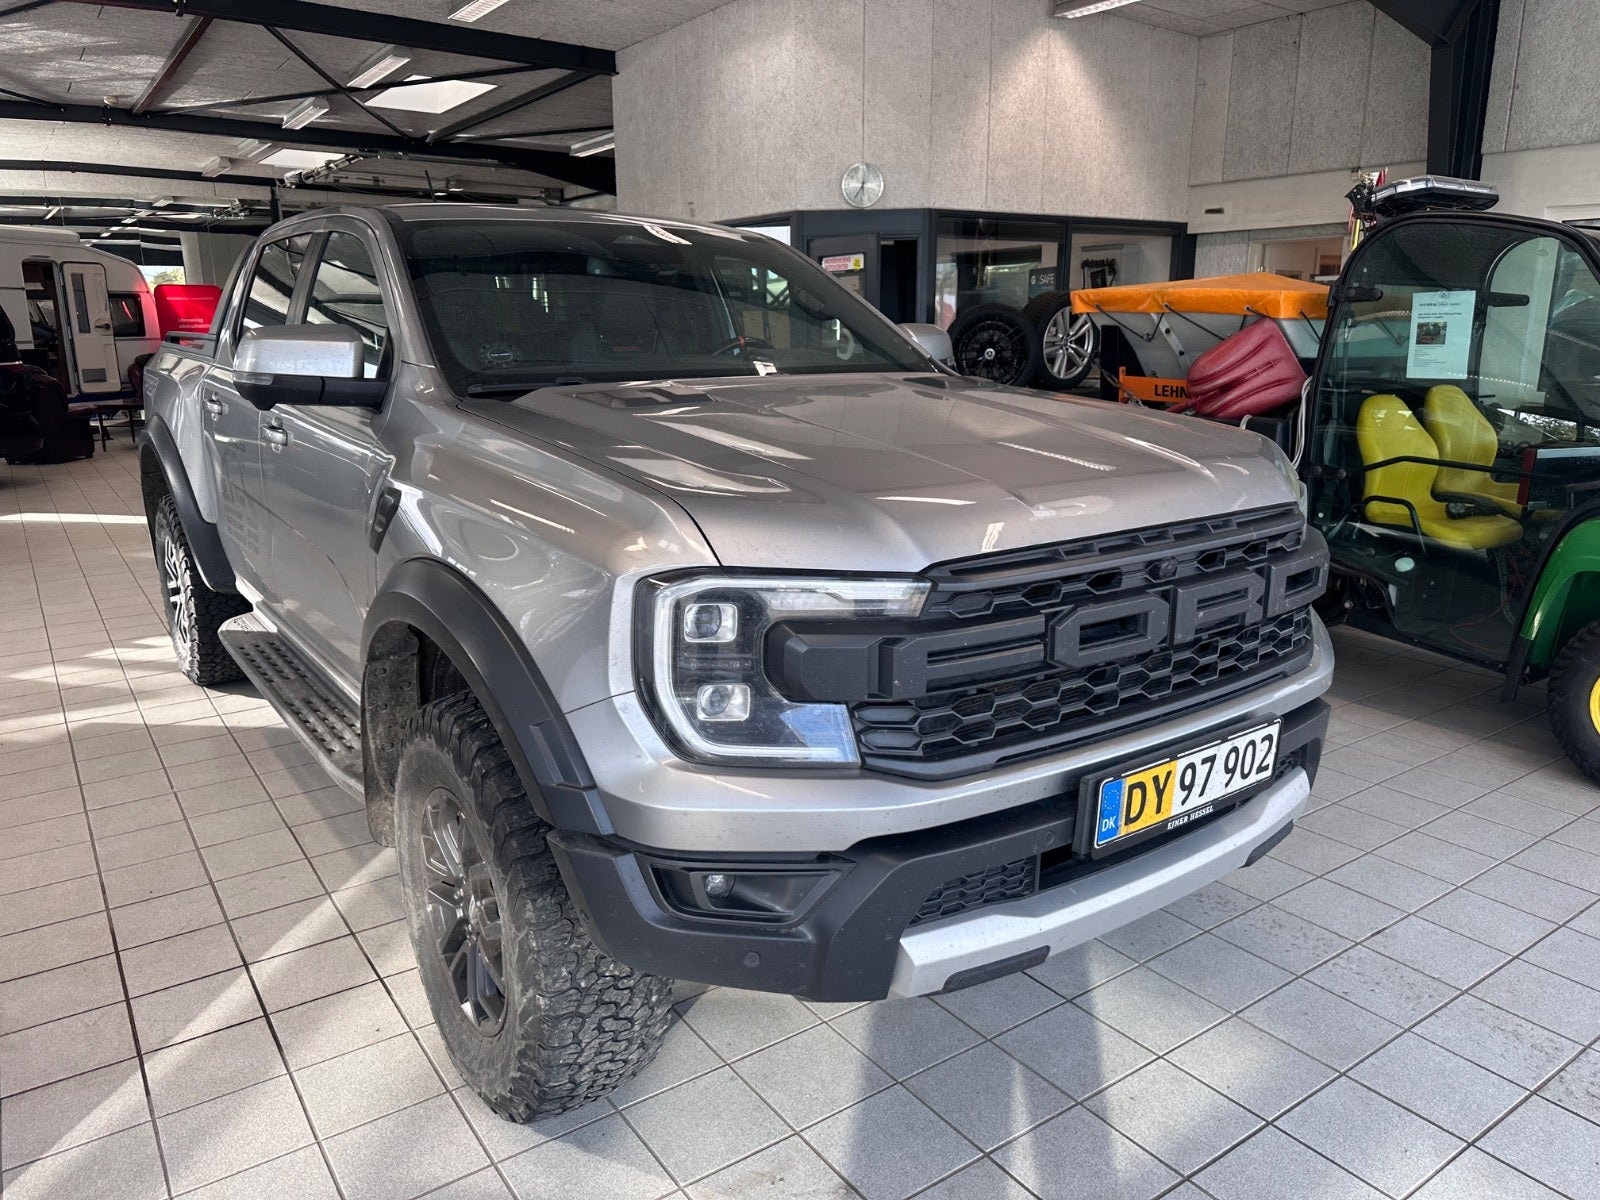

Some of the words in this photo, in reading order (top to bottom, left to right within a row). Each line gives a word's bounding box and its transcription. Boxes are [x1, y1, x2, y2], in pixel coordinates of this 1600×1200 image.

[893, 550, 1331, 700] FORD
[1124, 770, 1172, 826] DY
[1179, 754, 1217, 806] 97
[1224, 733, 1274, 788] 902
[1101, 815, 1116, 831] DK
[1189, 805, 1214, 821] HESSEL
